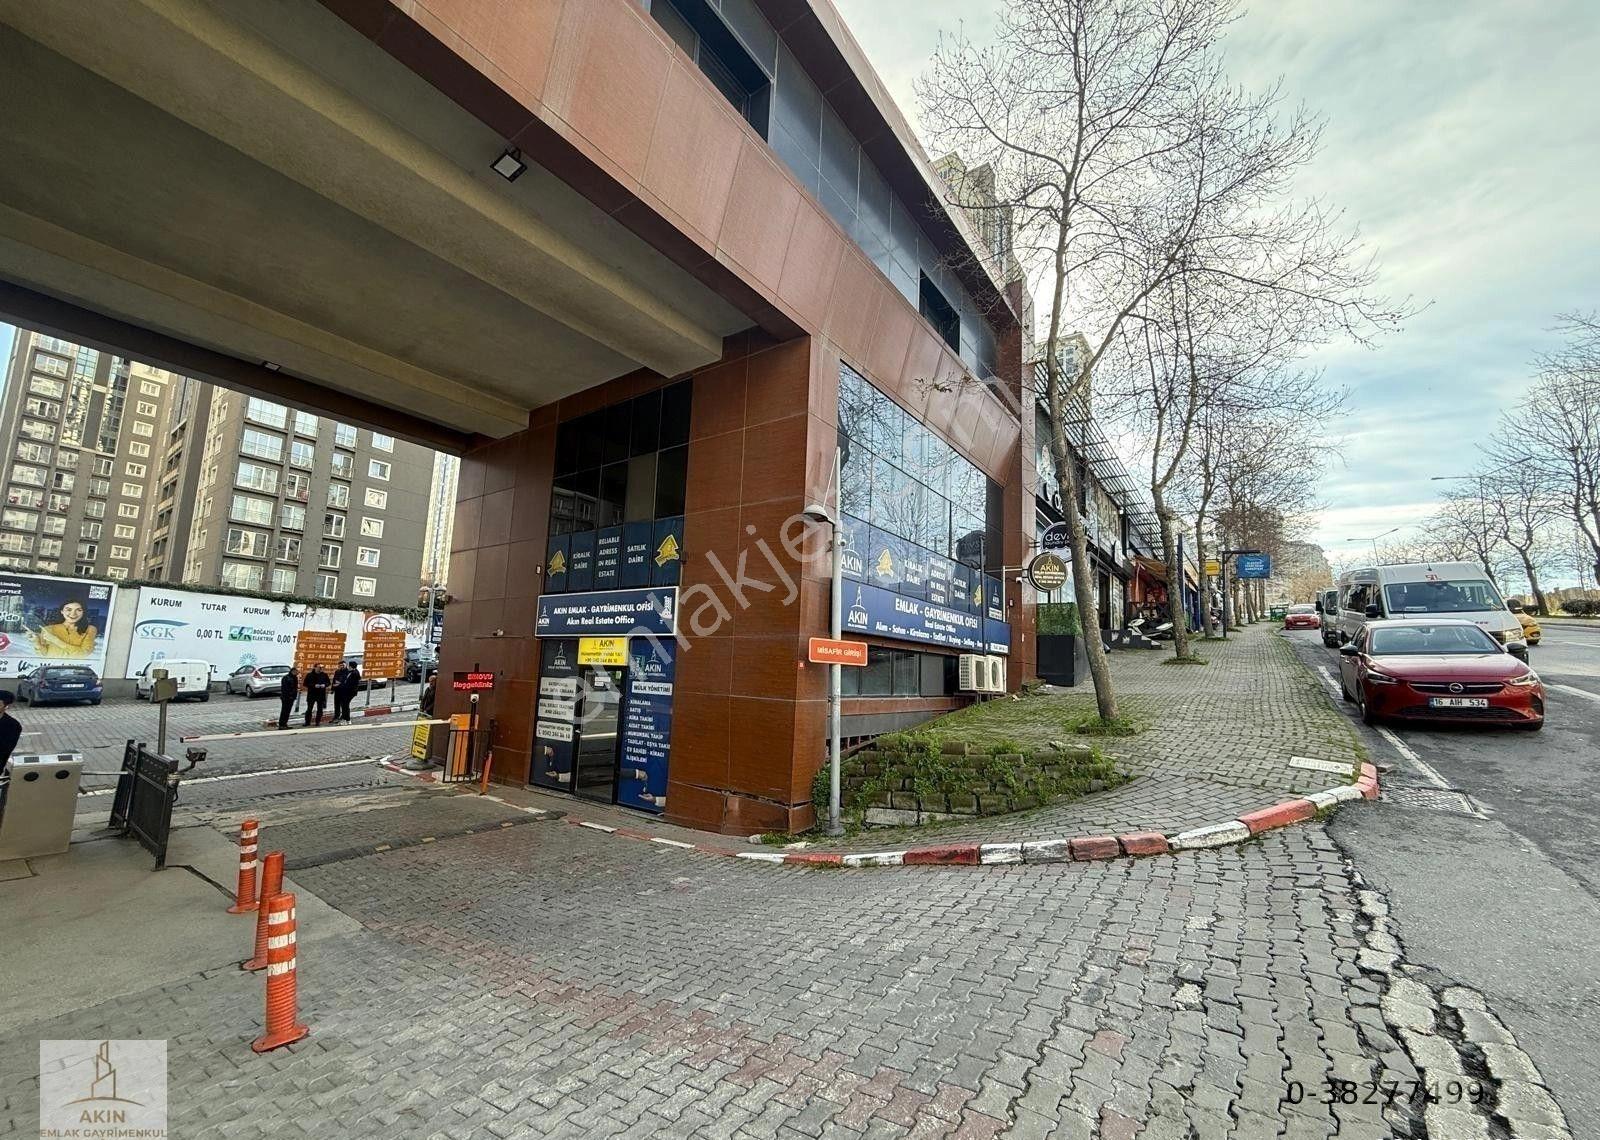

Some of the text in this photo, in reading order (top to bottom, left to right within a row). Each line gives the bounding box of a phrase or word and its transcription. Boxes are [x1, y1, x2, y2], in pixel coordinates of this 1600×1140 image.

[599, 536, 620, 545] RELIABLE
[1045, 532, 1070, 541] dev
[599, 548, 618, 556] ADRESS
[627, 544, 647, 552] SATILIK
[628, 554, 644, 564] DAİRE
[841, 554, 862, 573] AKIN
[1040, 564, 1060, 572] AKIN
[150, 597, 183, 608] KURUM
[201, 602, 227, 612] TUTAR
[568, 606, 587, 614] EMLAK
[591, 603, 635, 613] GAYRİMENKUL
[636, 601, 654, 611] OFİSİ
[243, 607, 271, 616] KURUM
[895, 597, 919, 615] EMLAK
[924, 607, 965, 626] GAYRİMENKUL
[581, 616, 595, 625] Real
[595, 616, 614, 625] Estate
[615, 616, 635, 624] Office
[848, 610, 868, 625] AKIN
[141, 625, 175, 638] SGK
[196, 629, 223, 640] 0,00 TL
[277, 634, 291, 645] 0,00
[816, 646, 843, 656] MİSAFİR
[645, 664, 662, 673] AKIN
[1434, 698, 1443, 706] 16
[1469, 699, 1486, 707] 534
